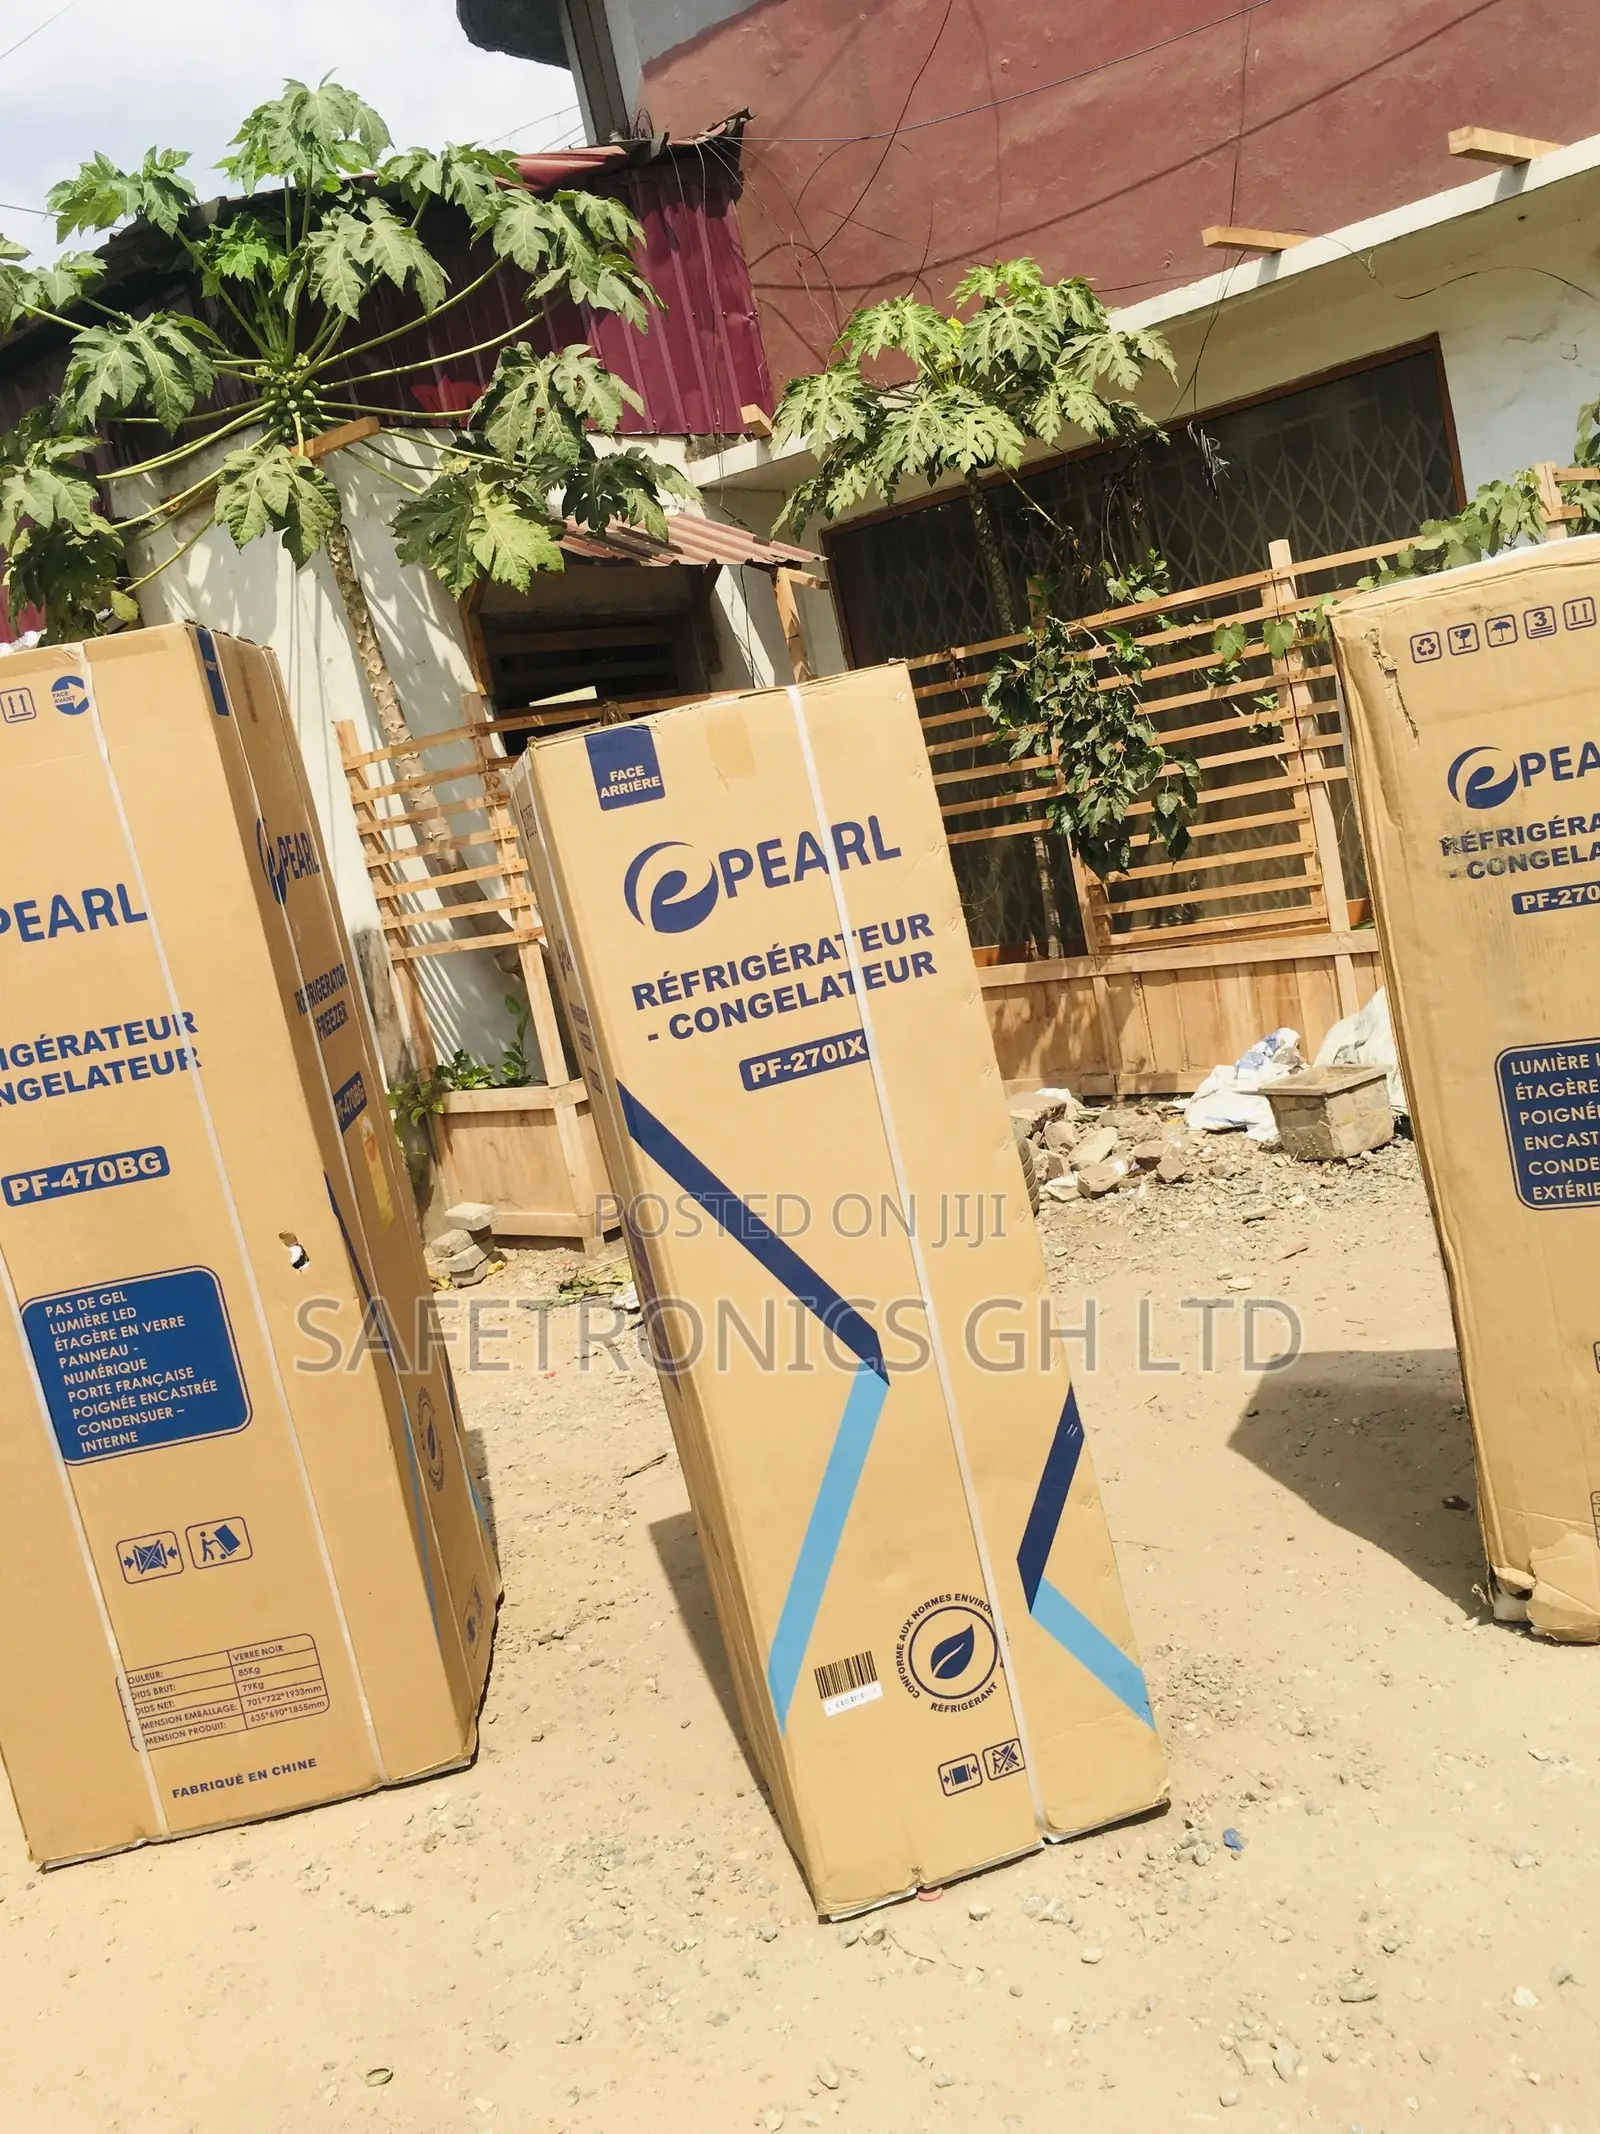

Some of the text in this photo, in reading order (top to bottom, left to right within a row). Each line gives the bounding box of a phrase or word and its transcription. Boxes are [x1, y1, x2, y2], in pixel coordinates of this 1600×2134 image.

[600, 776, 661, 799] ARRIÈRE
[609, 765, 645, 782] FACE
[277, 832, 320, 882] PEARL
[718, 815, 902, 899] PEARL
[669, 951, 938, 1041] CONGELATEUR
[316, 1000, 349, 1042] FREEZER
[750, 1036, 867, 1083] PF-270IX
[1511, 1053, 1590, 1076] LUMIÈRE
[1515, 1078, 1600, 1101] ÉTAGÈRE
[1520, 1101, 1600, 1126] POIGNÉ
[1524, 1131, 1599, 1151] ENCAST
[9, 1152, 162, 1202] PF-470BG
[1528, 1157, 1600, 1176] CONDE
[1532, 1180, 1600, 1201] EXTÉRIE
[45, 1291, 127, 1318] PAS DE GEL
[50, 1306, 137, 1335] LUMIÈRE LED
[54, 1315, 186, 1352] ÉTAGÈRE EN VERRE
[59, 1344, 129, 1369] PANNEAU
[63, 1358, 148, 1386] NUMÉRIQUE
[68, 1367, 195, 1402] PORTE FRANÇAISE
[72, 1380, 218, 1419] POIGNÉE ENCASTRÉE
[77, 1407, 174, 1436] CONDENSUER
[81, 1431, 138, 1453] INTERNE
[911, 1594, 952, 1620] NORMES
[899, 1619, 914, 1641] AUX
[128, 1645, 284, 1685] OULEUR: VERRE NOIR
[896, 1643, 920, 1698] CONFORME
[132, 1666, 261, 1700] OIDS BRUT: 85Kg
[930, 1682, 998, 1713] RÉFRIGÉRANT
[136, 1681, 264, 1715] OIDS NET: 79Kg
[141, 1715, 182, 1730] MENSION
[184, 1703, 238, 1721] EMBALLAGE:
[145, 1730, 186, 1746] MENSION
[188, 1722, 227, 1737] PRODUIT:
[172, 1758, 318, 1799] FABRIQUÉ EN CHINE
